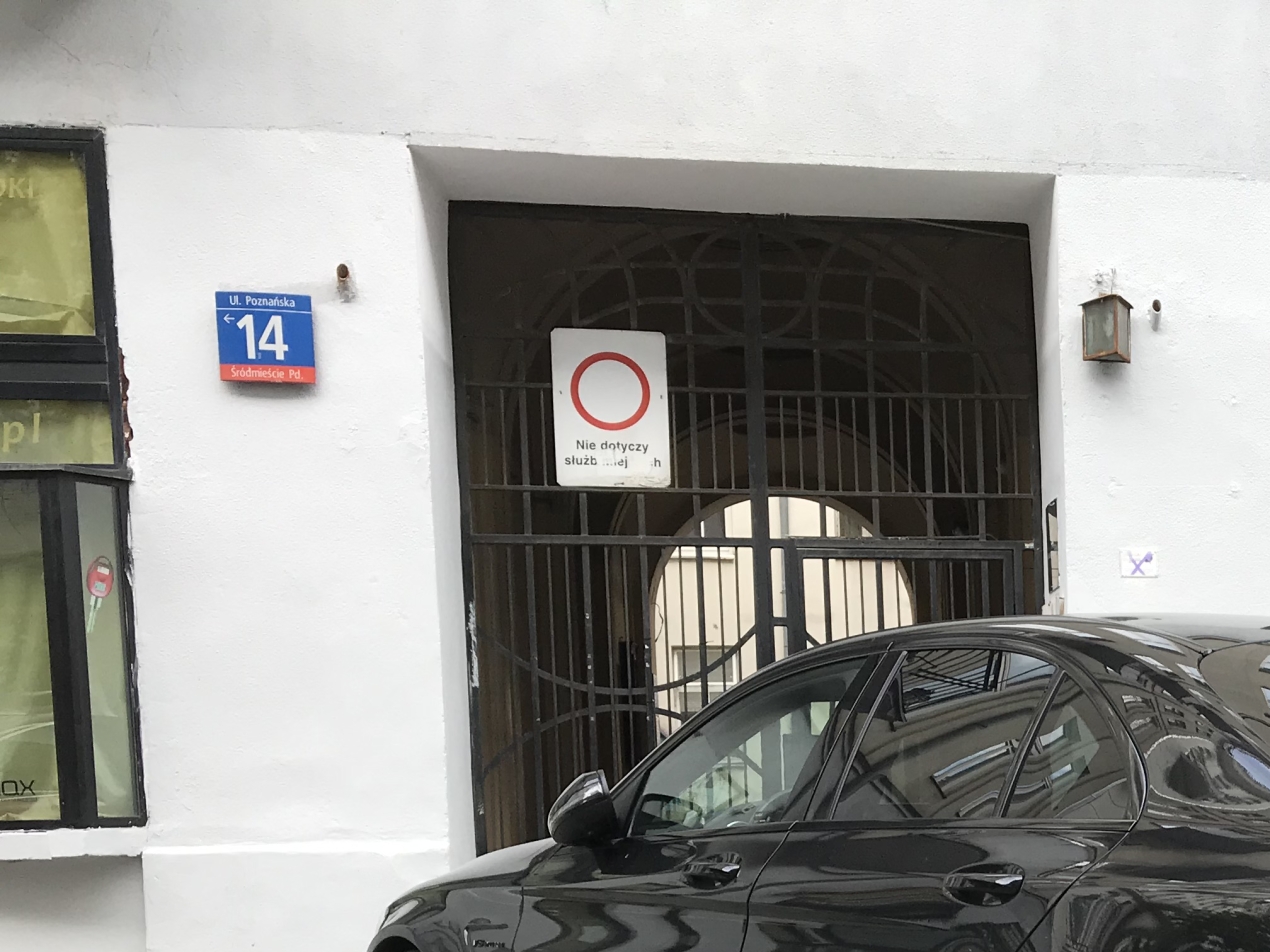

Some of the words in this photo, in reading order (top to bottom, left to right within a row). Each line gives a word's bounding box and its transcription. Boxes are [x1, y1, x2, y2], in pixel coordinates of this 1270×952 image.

[229, 295, 242, 306] Ul.
[246, 295, 296, 308] Poznańska
[236, 314, 289, 360] 14
[231, 365, 285, 379] Śródmieście
[289, 369, 304, 380] Pd.
[576, 440, 597, 450] Nie
[600, 441, 649, 454] dotyczy
